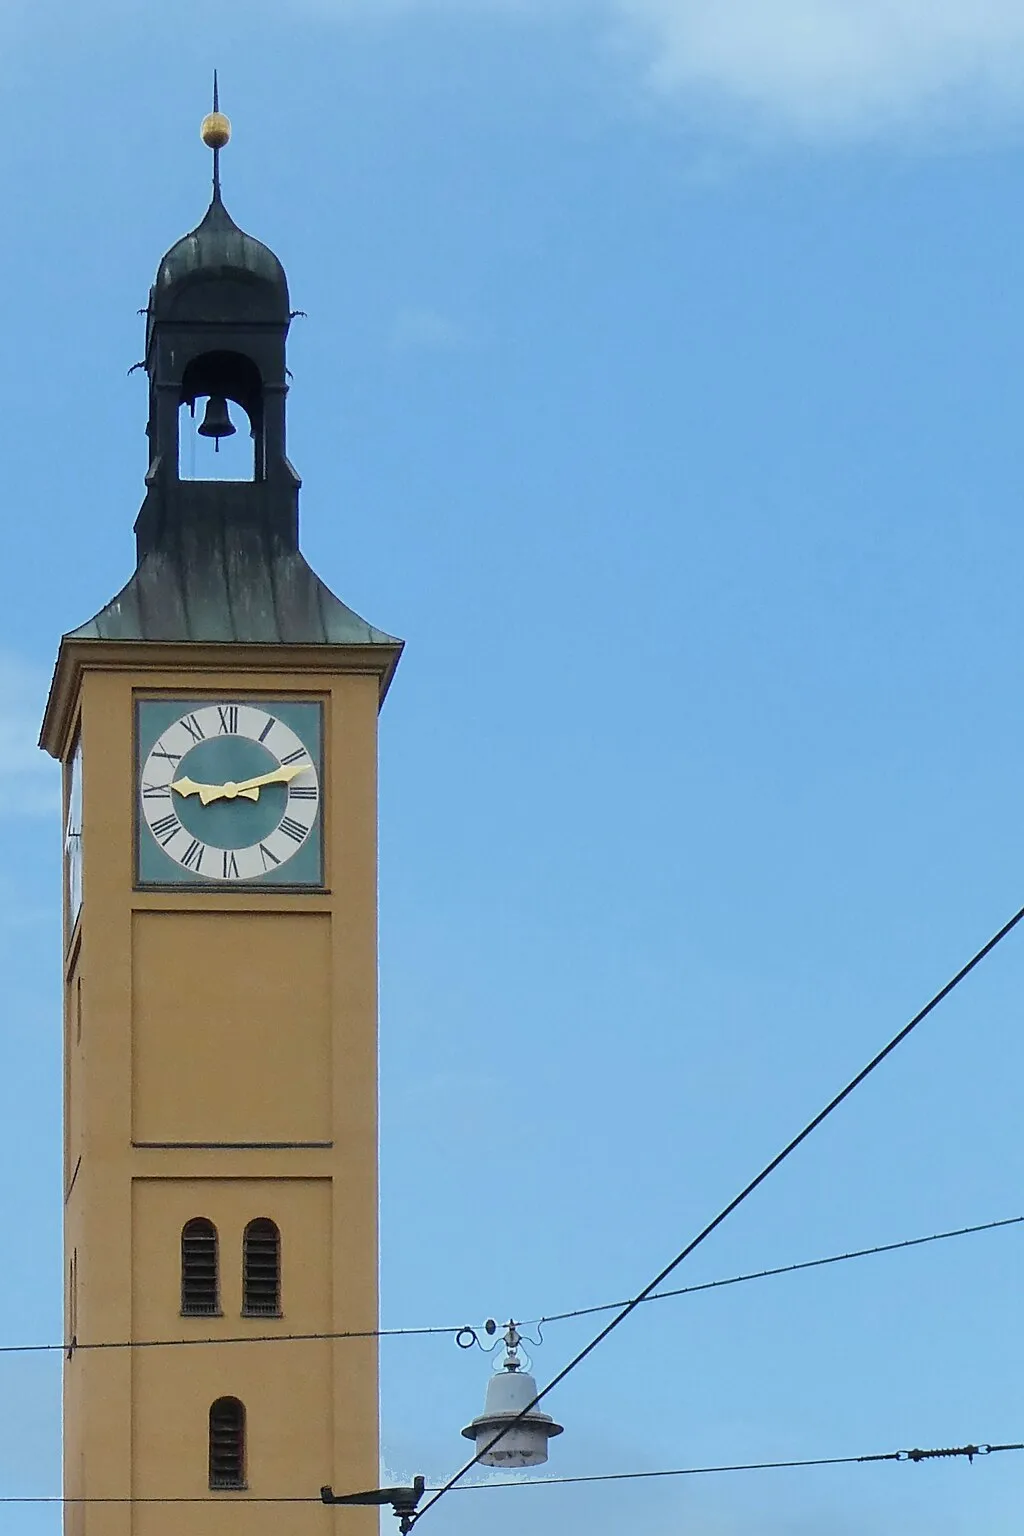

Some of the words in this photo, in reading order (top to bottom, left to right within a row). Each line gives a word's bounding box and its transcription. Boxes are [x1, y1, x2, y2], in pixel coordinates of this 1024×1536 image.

[179, 714, 206, 744] XI
[217, 706, 238, 734] XII
[258, 717, 276, 743] I
[151, 741, 182, 768] X
[280, 747, 307, 766] II
[289, 786, 317, 800] III
[150, 813, 182, 847] VIII
[180, 839, 205, 872] VII
[223, 851, 240, 878] VI
[259, 843, 282, 871] V
